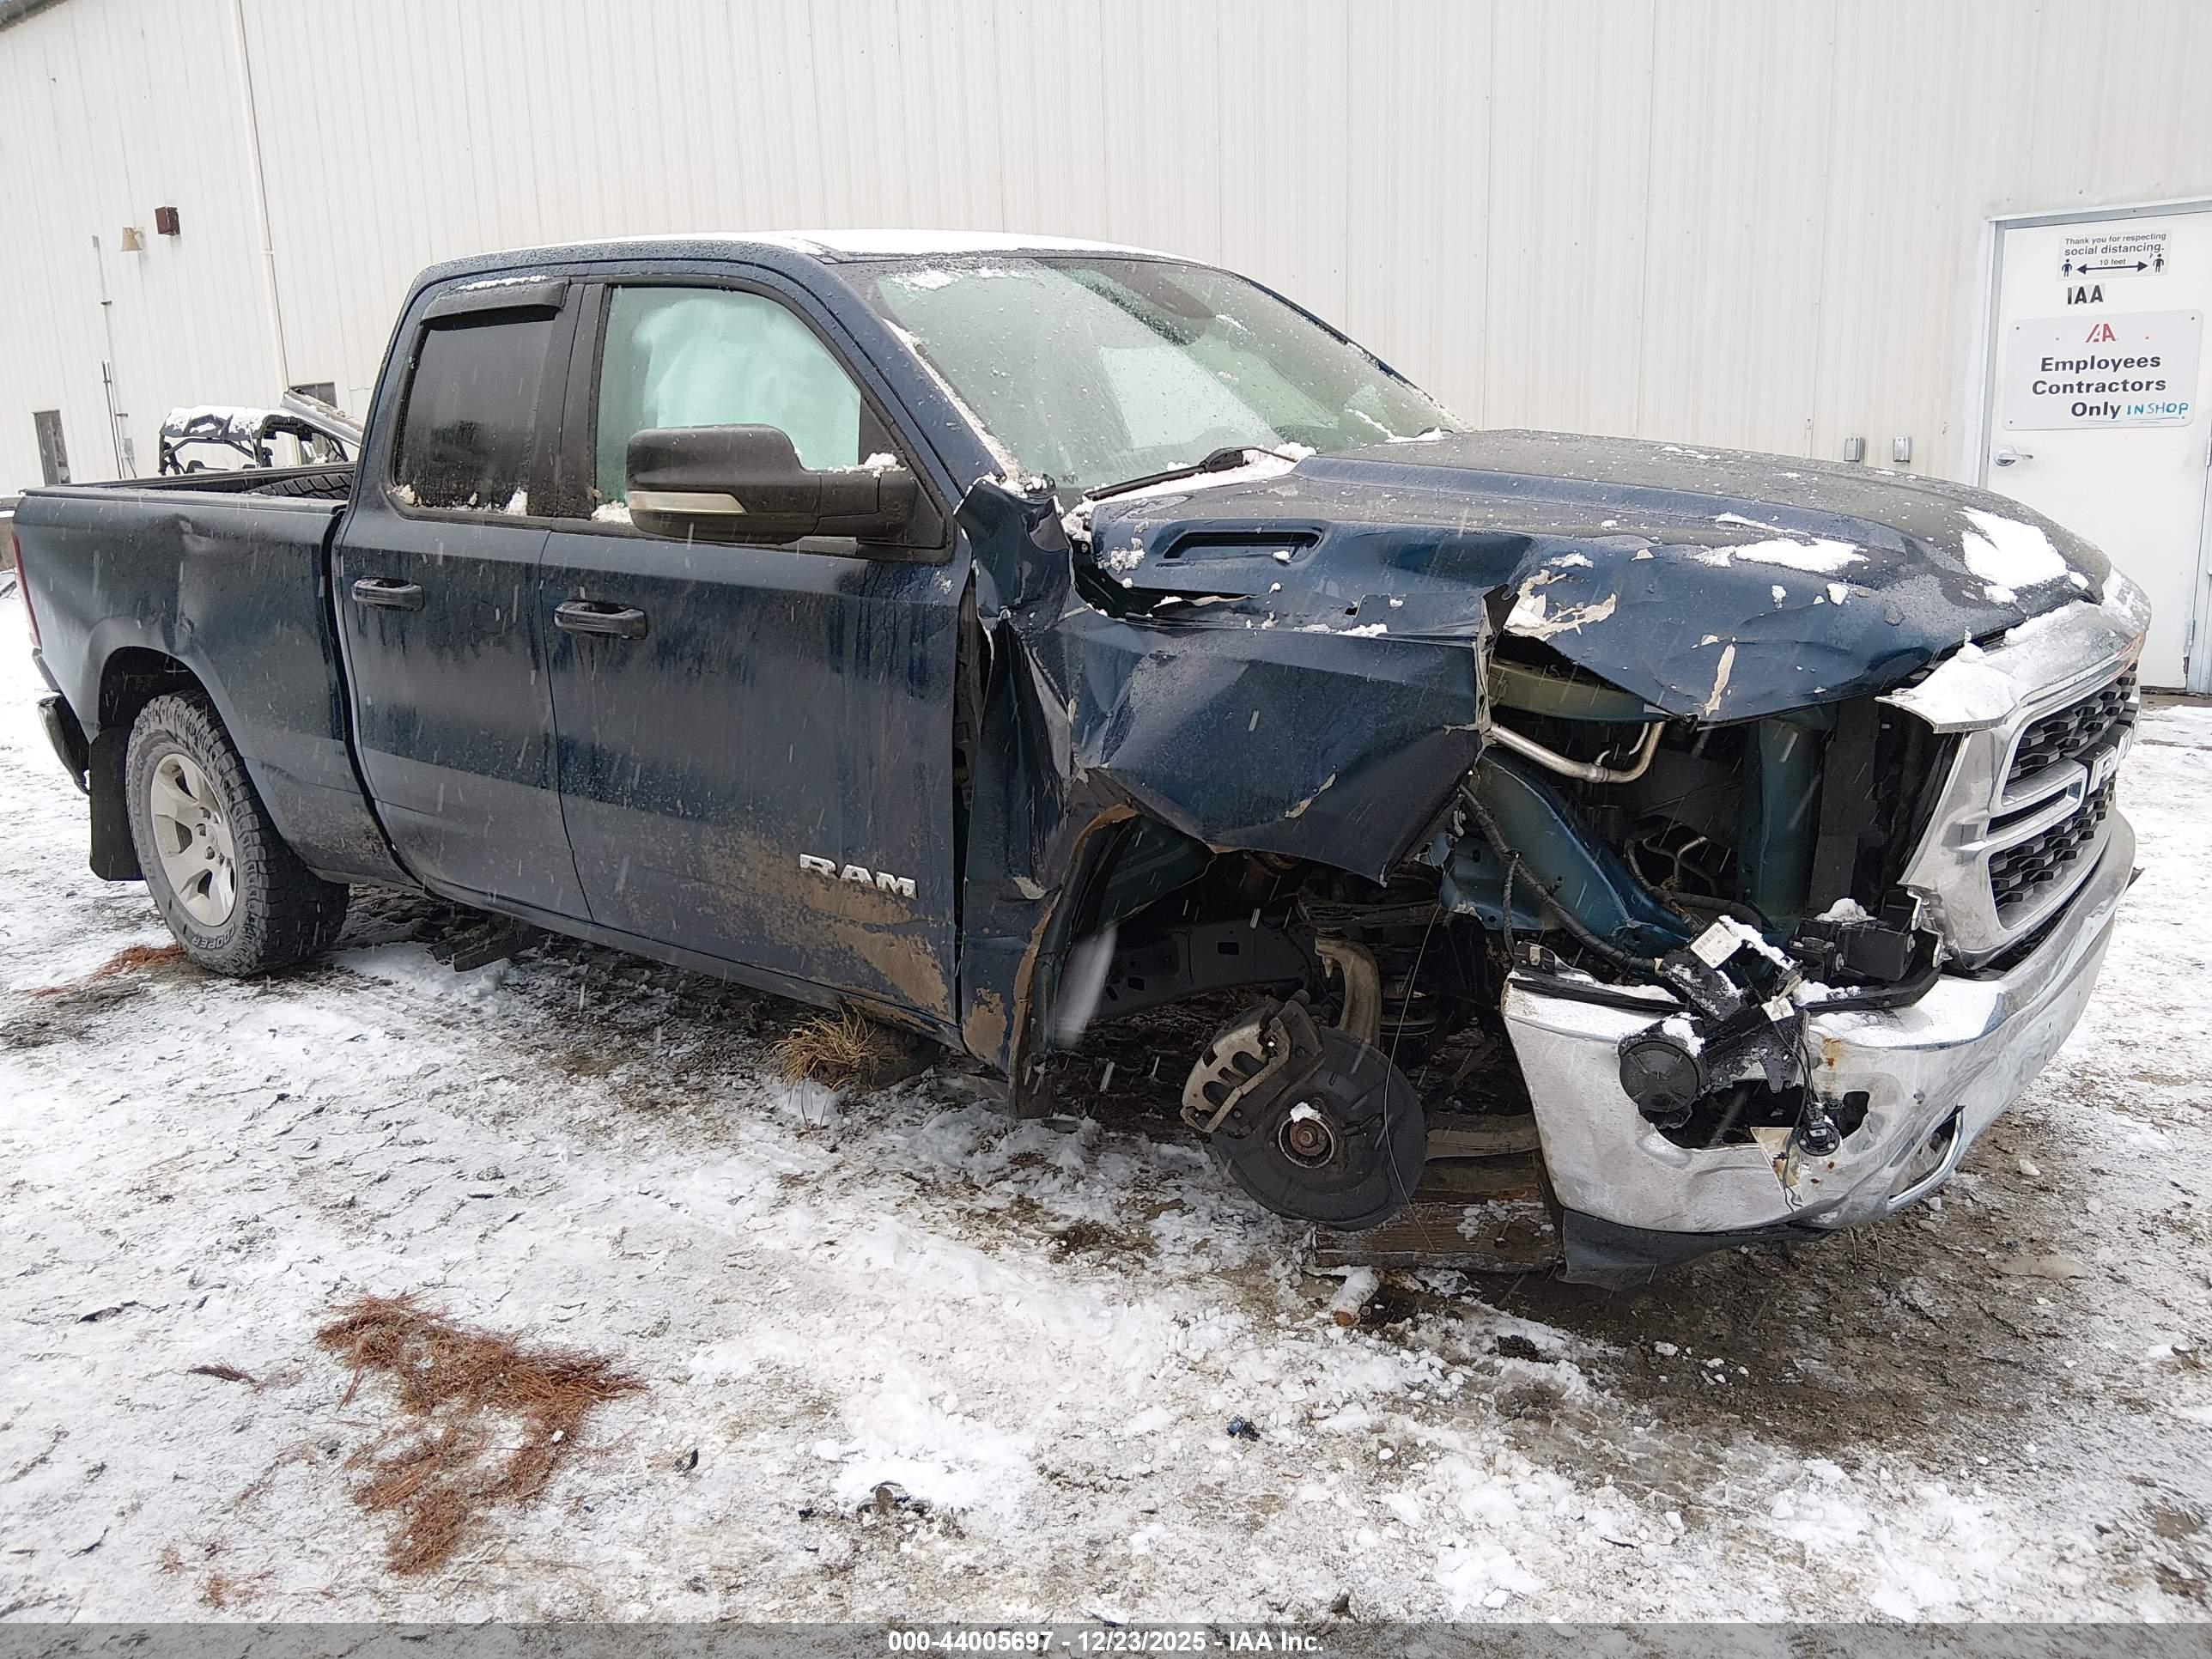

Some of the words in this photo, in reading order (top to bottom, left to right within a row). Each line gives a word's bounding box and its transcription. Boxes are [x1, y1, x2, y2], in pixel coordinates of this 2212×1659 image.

[2065, 237, 2090, 246] Thank
[2109, 234, 2121, 243] for
[2122, 233, 2167, 242] respecting
[2064, 246, 2098, 257] social
[2100, 242, 2165, 253] distancing.
[2067, 284, 2104, 305] IAA
[2040, 355, 2161, 374] Employees
[2032, 379, 2167, 395] Contractors
[2071, 401, 2122, 420] Only
[799, 853, 919, 900] RAM
